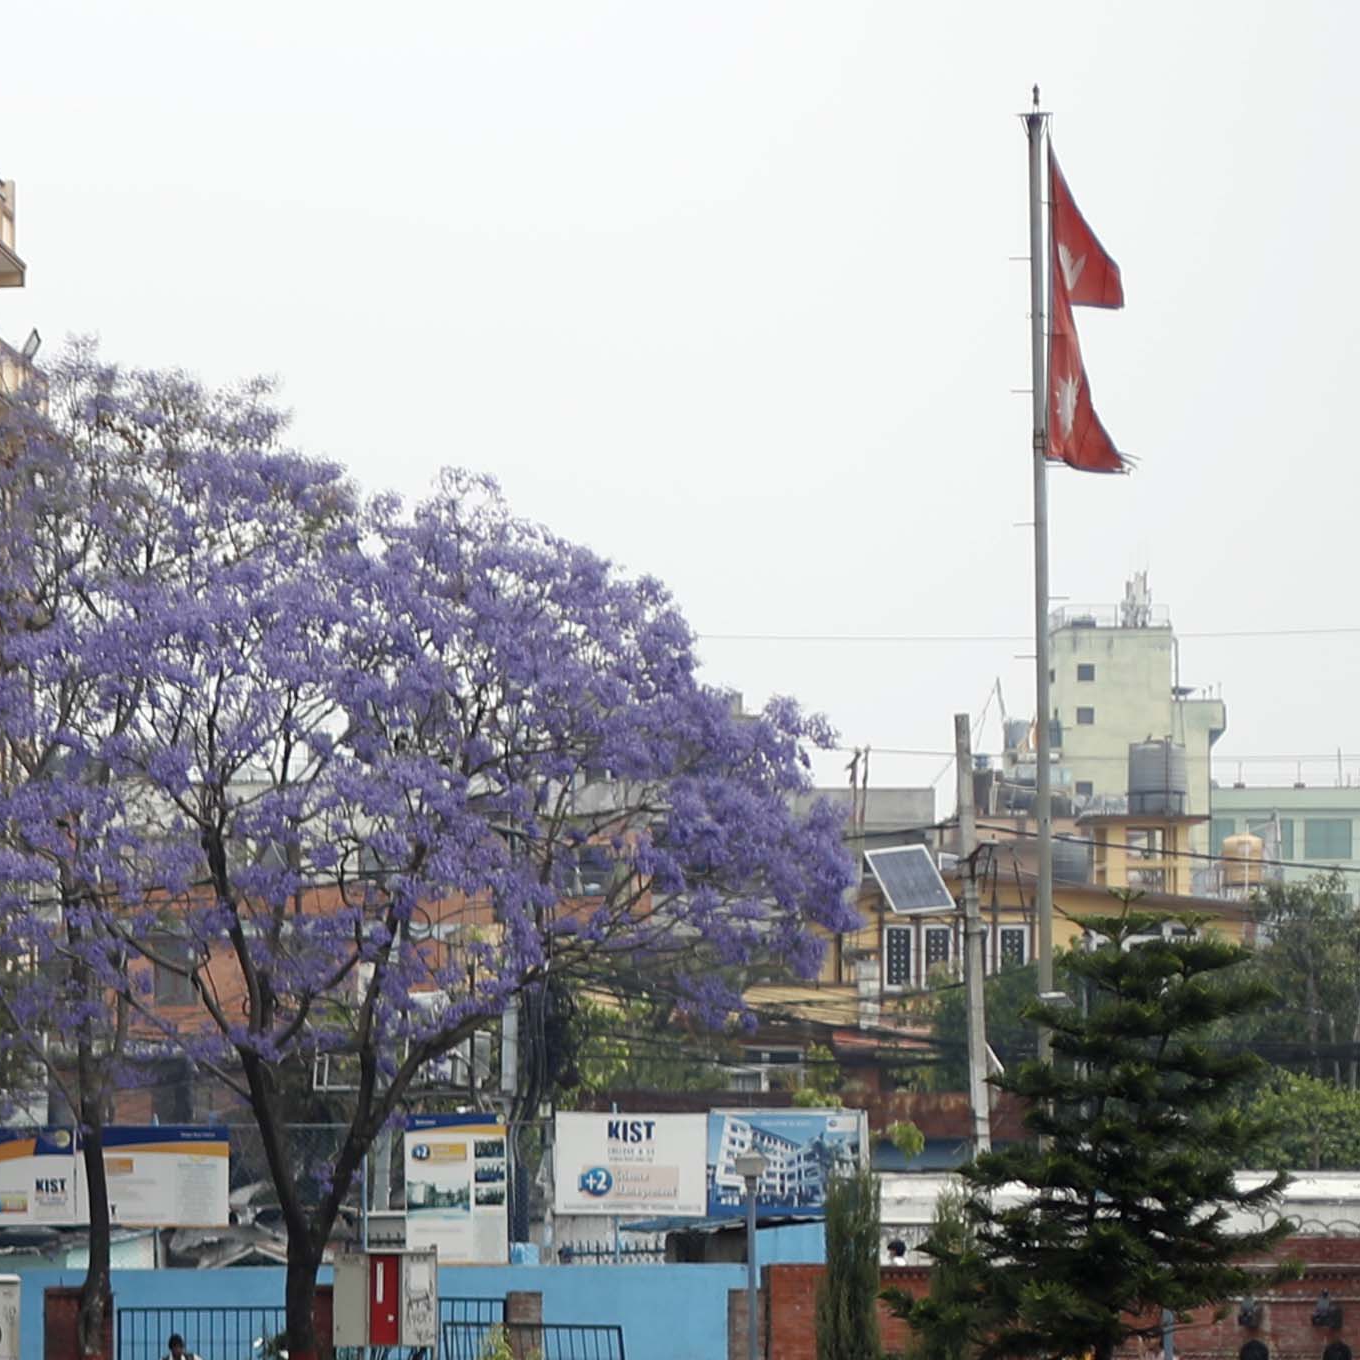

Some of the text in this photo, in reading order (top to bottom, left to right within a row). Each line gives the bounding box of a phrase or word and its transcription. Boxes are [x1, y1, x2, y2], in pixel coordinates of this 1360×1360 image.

[607, 1120, 656, 1143] KIST
[35, 1178, 67, 1194] KIST
[585, 1169, 607, 1191] +2
